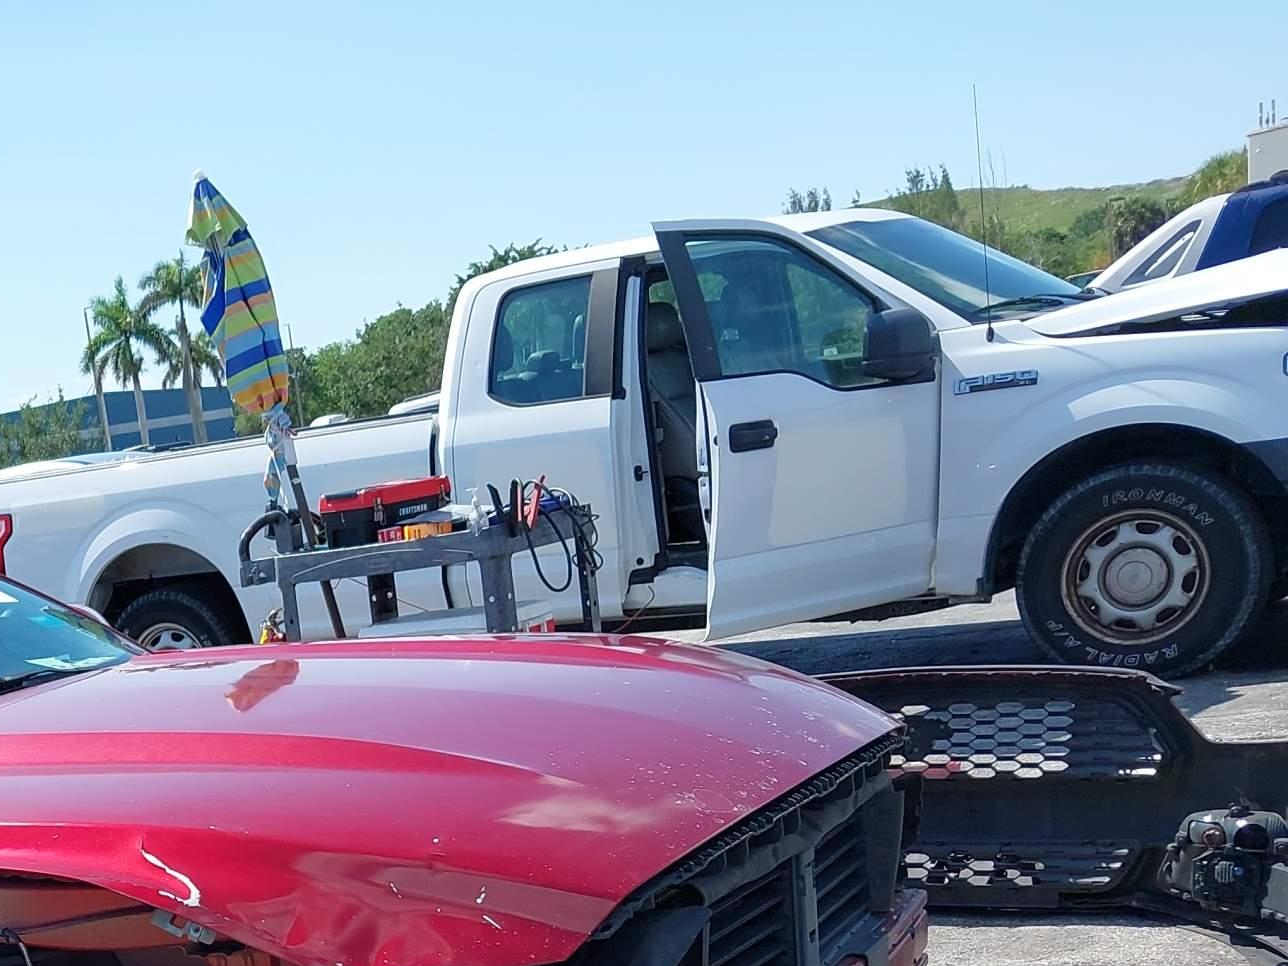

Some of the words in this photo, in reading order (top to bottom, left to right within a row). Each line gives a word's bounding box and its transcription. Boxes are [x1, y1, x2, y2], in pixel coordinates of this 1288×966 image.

[399, 503, 428, 516] CRAFTSMAN
[1102, 488, 1214, 525] IRONMAN
[1046, 620, 1083, 648] A/P
[1085, 643, 1178, 666] RADIAL
